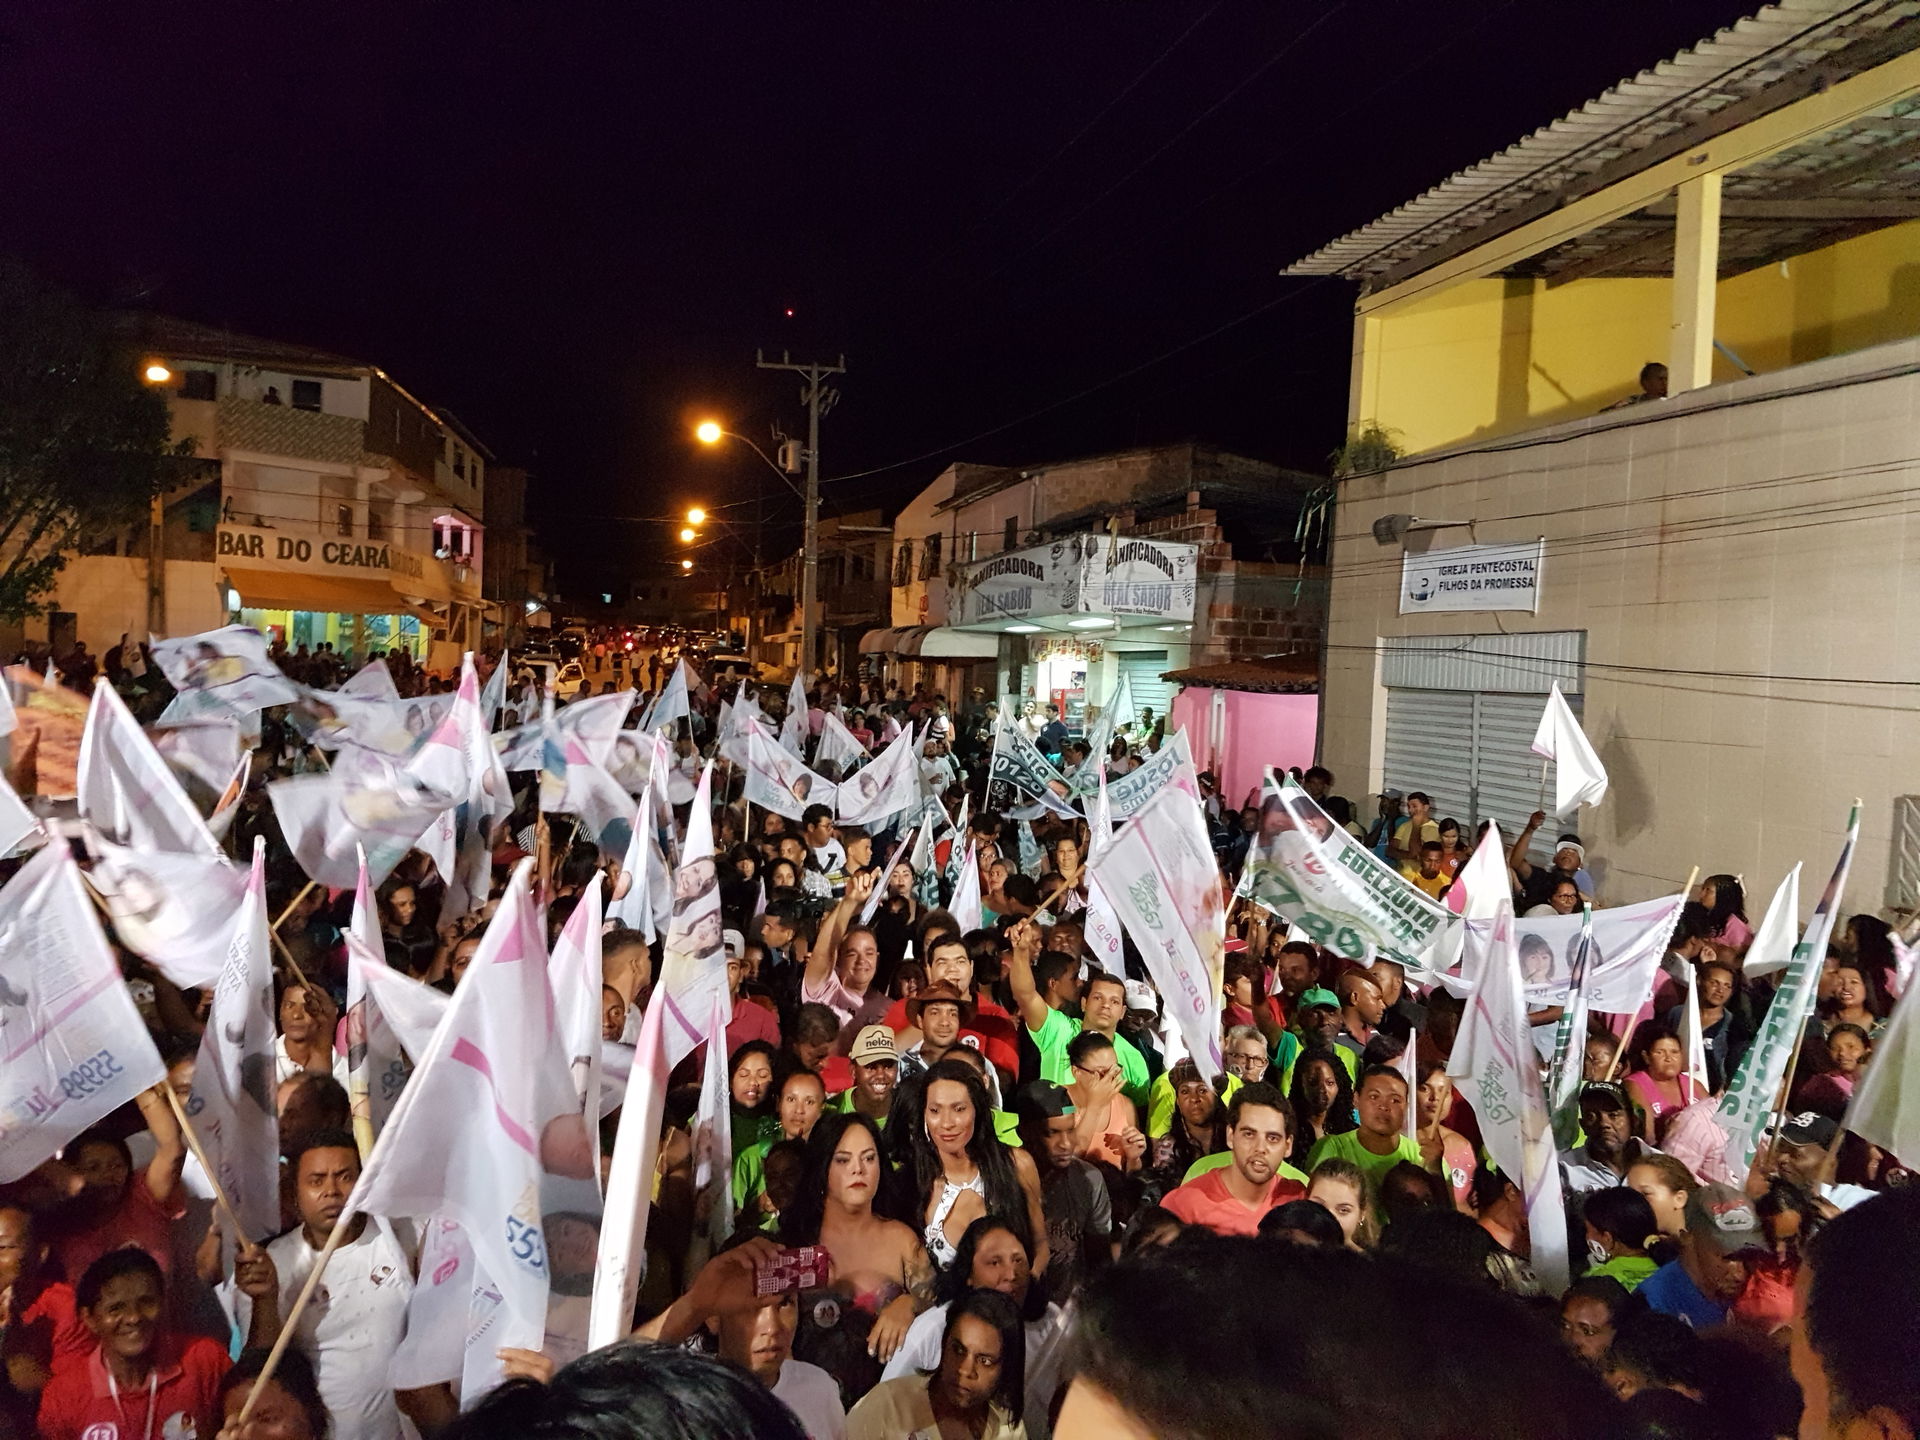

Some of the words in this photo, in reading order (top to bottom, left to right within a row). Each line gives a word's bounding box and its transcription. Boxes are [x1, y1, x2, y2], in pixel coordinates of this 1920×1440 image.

[218, 531, 264, 558] BAR
[276, 537, 312, 562] DO
[322, 543, 391, 569] CEARÁ
[1106, 542, 1175, 581] PANIFICADORA
[1439, 564, 1468, 576] IGREJA
[1470, 560, 1534, 575] PENTECOSTAL
[997, 585, 1032, 611] SABOR
[1103, 579, 1129, 605] REAL
[1132, 583, 1171, 611] SABOR
[1439, 579, 1468, 591] FILHOS
[1470, 579, 1482, 590] DA
[1484, 577, 1534, 589] PROMESSA
[1129, 884, 1163, 930] 20567
[1337, 845, 1440, 934] EDELZUITA
[1477, 1079, 1515, 1126] 20567
